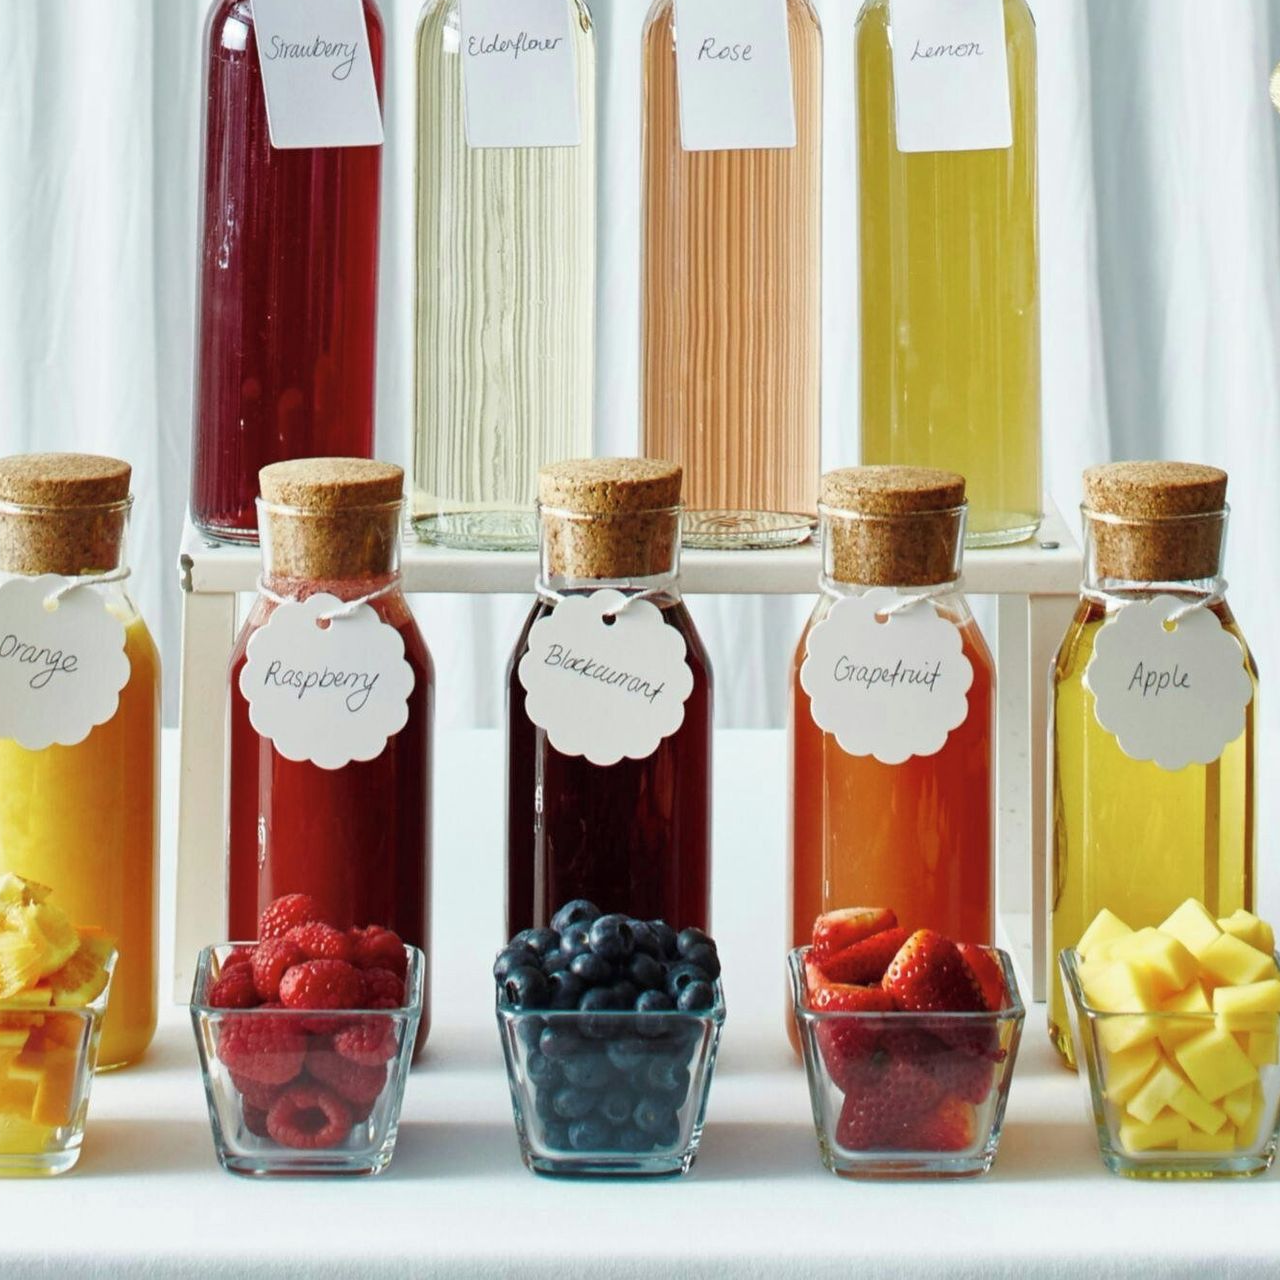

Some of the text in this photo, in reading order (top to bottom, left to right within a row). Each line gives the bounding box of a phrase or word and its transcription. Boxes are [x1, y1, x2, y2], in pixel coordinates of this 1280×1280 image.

[468, 32, 563, 60] Elderflower
[697, 37, 752, 61] Rose
[910, 39, 984, 61] Lemon
[264, 660, 380, 713] Raspberry
[544, 644, 666, 704] Blackcurrant
[834, 655, 942, 693] Grapefruit
[1128, 661, 1191, 697] Apple
